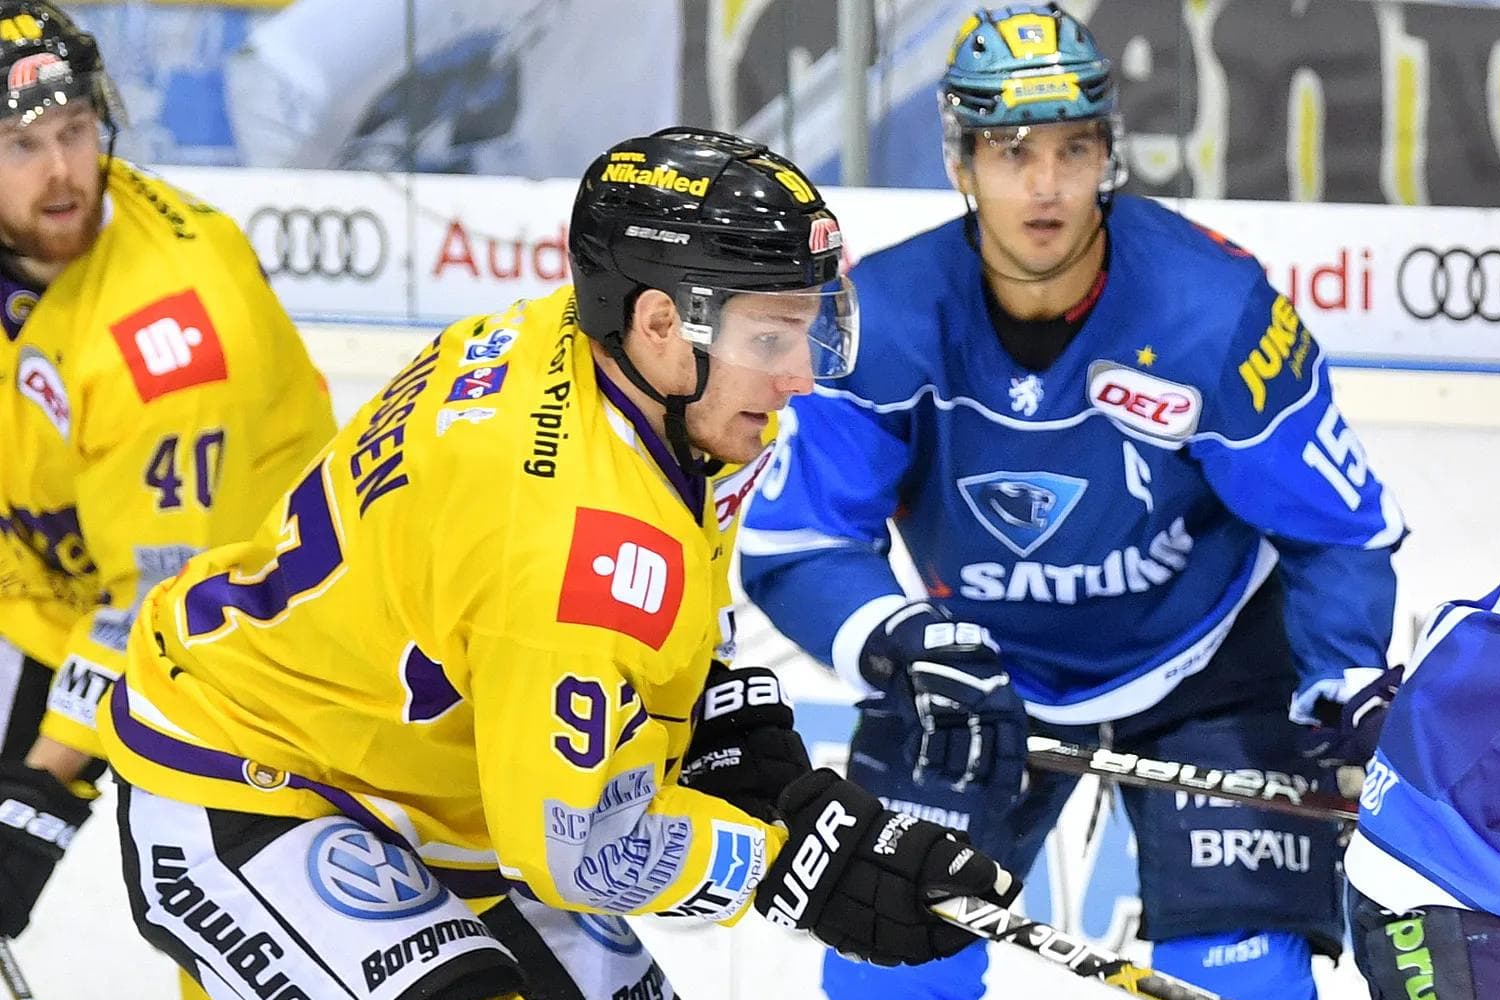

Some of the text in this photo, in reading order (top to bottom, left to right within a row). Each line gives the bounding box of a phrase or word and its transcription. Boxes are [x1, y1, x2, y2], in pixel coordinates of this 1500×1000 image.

[601, 163, 710, 198] NikaMed
[433, 218, 571, 281] Aud
[523, 380, 571, 479] Piping
[1095, 383, 1190, 426] DEL
[1302, 403, 1373, 512] 15
[1190, 829, 1311, 873] BRÄU
